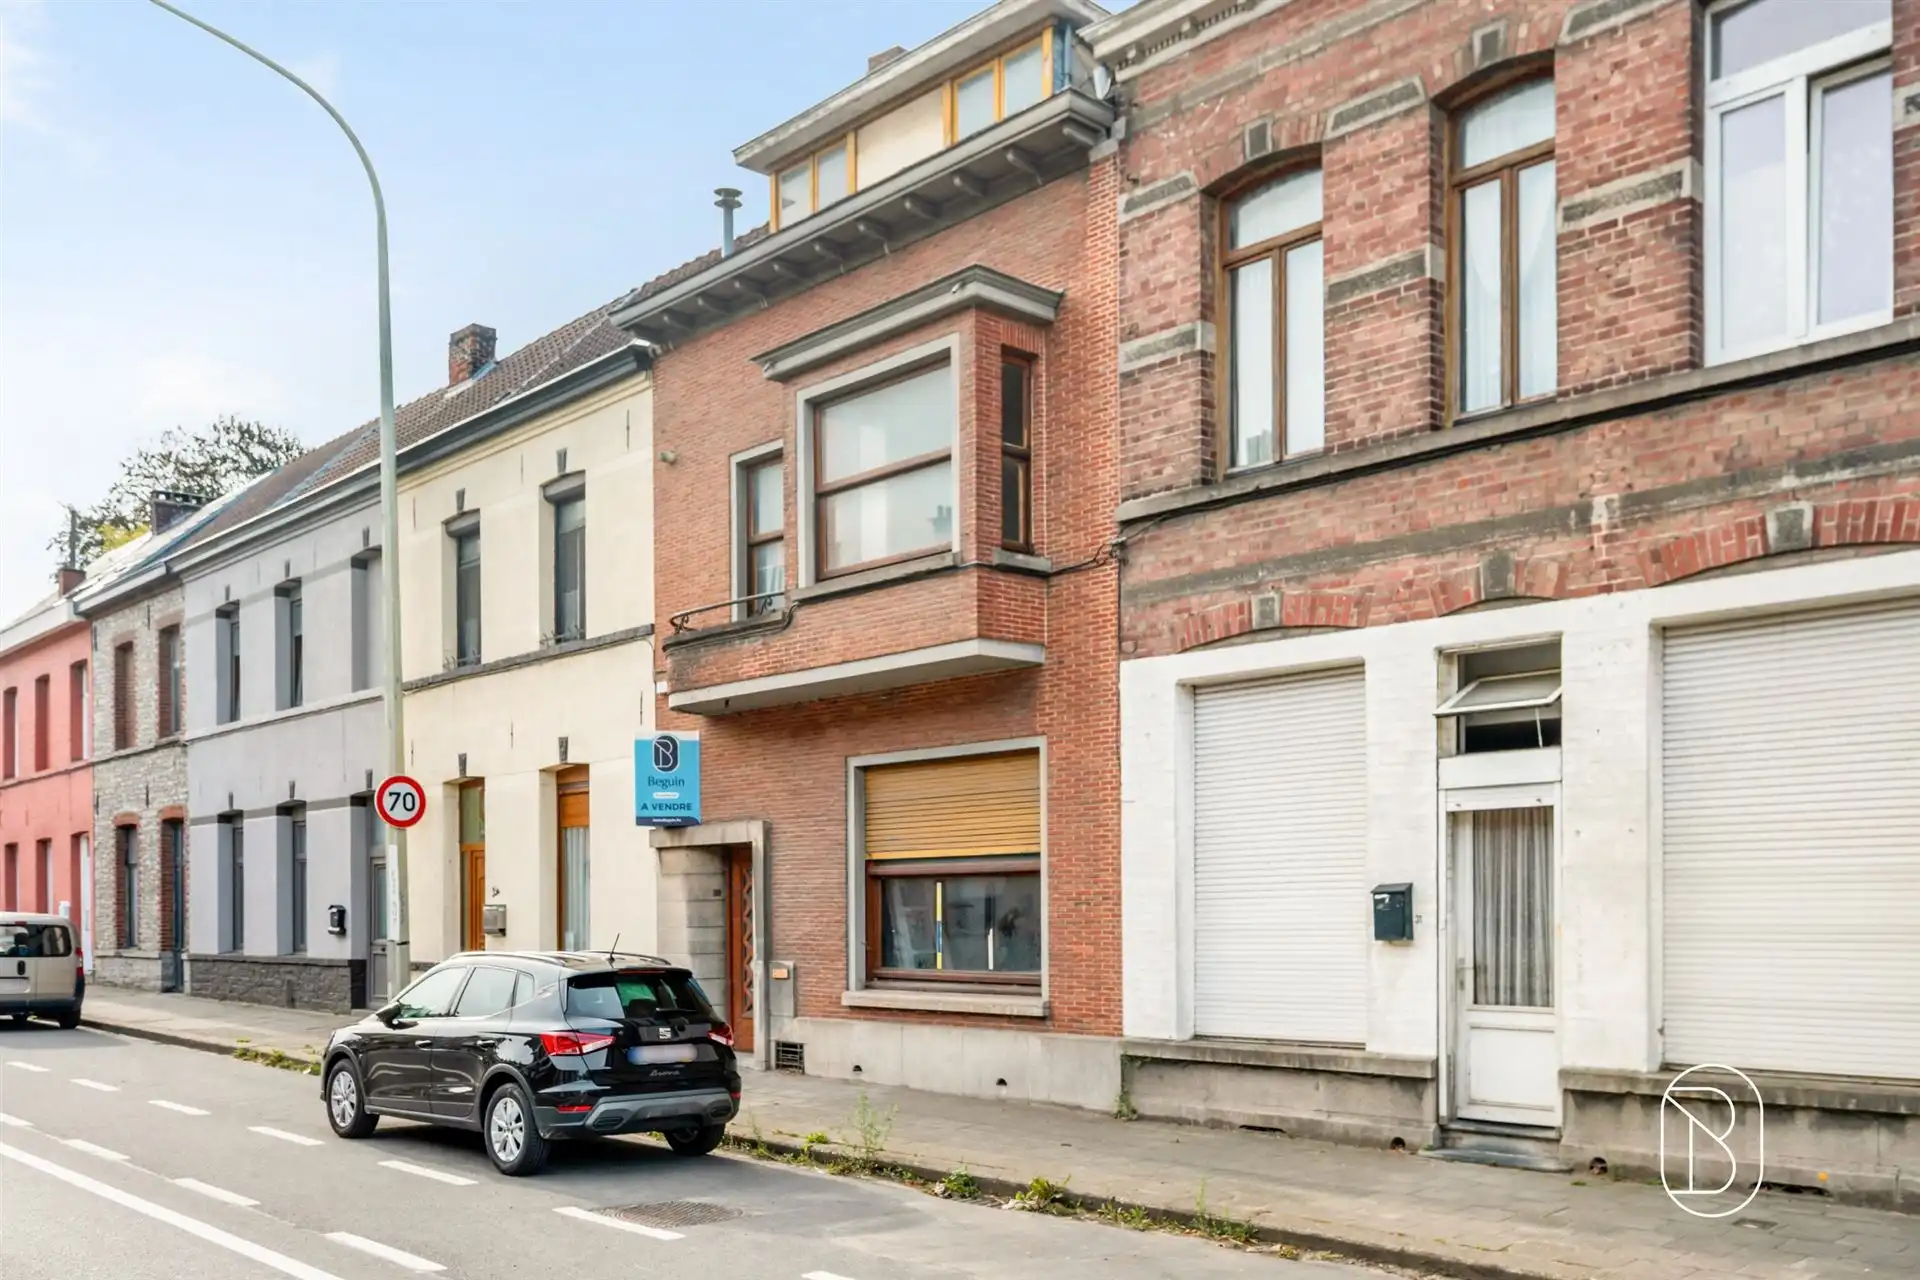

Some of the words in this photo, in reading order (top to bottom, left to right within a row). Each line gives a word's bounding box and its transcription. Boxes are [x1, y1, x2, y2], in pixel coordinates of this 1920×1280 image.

[653, 738, 674, 768] B
[647, 776, 686, 790] Beguin
[388, 791, 416, 812] 70
[640, 802, 649, 811] A
[651, 802, 693, 811] VENDRE
